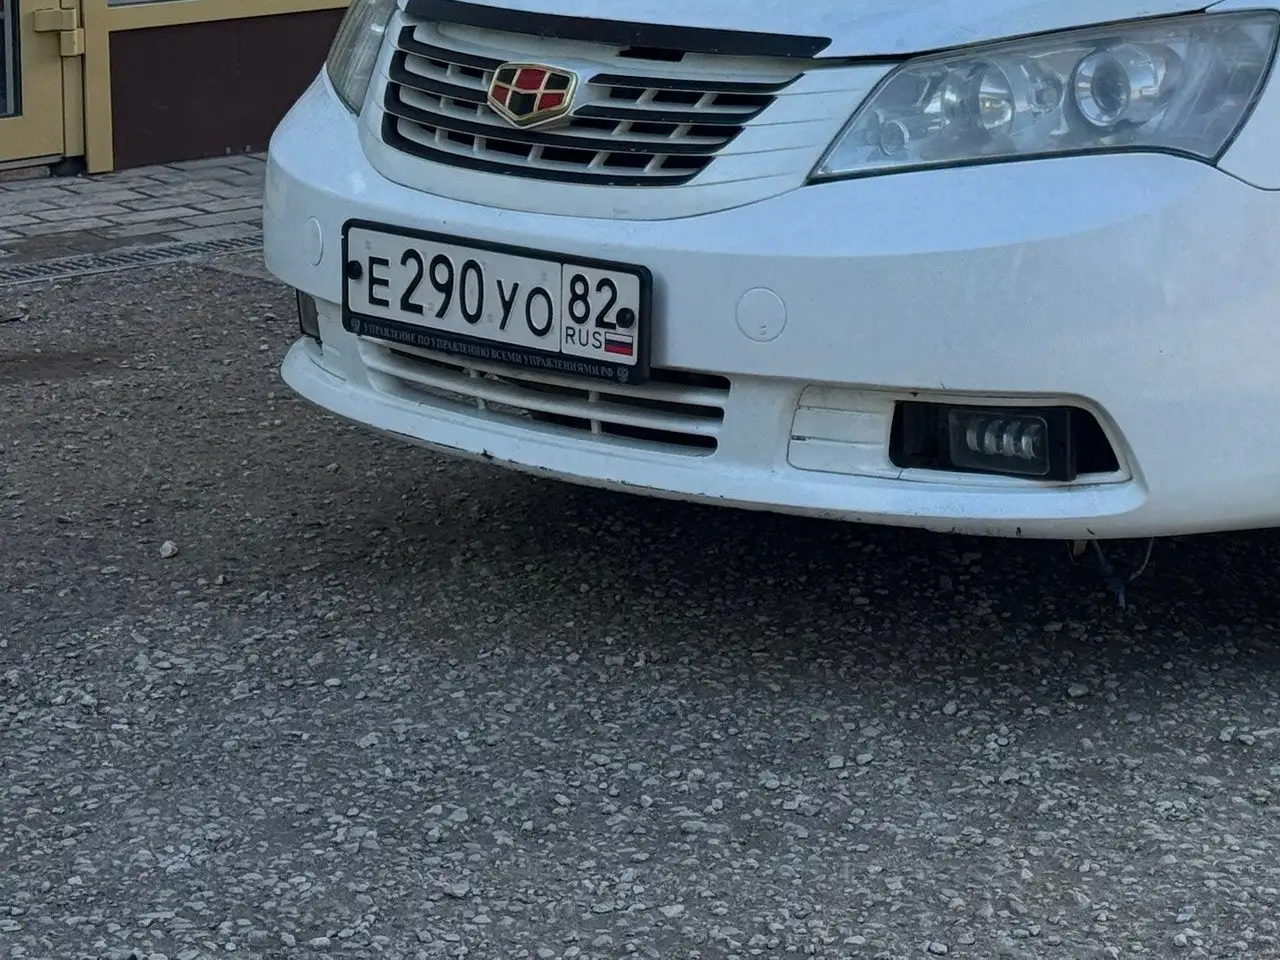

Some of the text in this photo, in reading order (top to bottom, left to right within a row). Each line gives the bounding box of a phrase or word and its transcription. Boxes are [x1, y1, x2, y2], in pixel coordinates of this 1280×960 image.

[569, 273, 618, 330] 82
[364, 322, 416, 342] УПРАВЛЕНИЕ
[418, 334, 430, 346] ПО
[432, 338, 490, 358] УПРАВЛЕНИЮ
[491, 348, 522, 364] ВСЕМИ
[523, 355, 600, 375] УПРАВЛЕНИЯМИ
[565, 326, 602, 350] RUS
